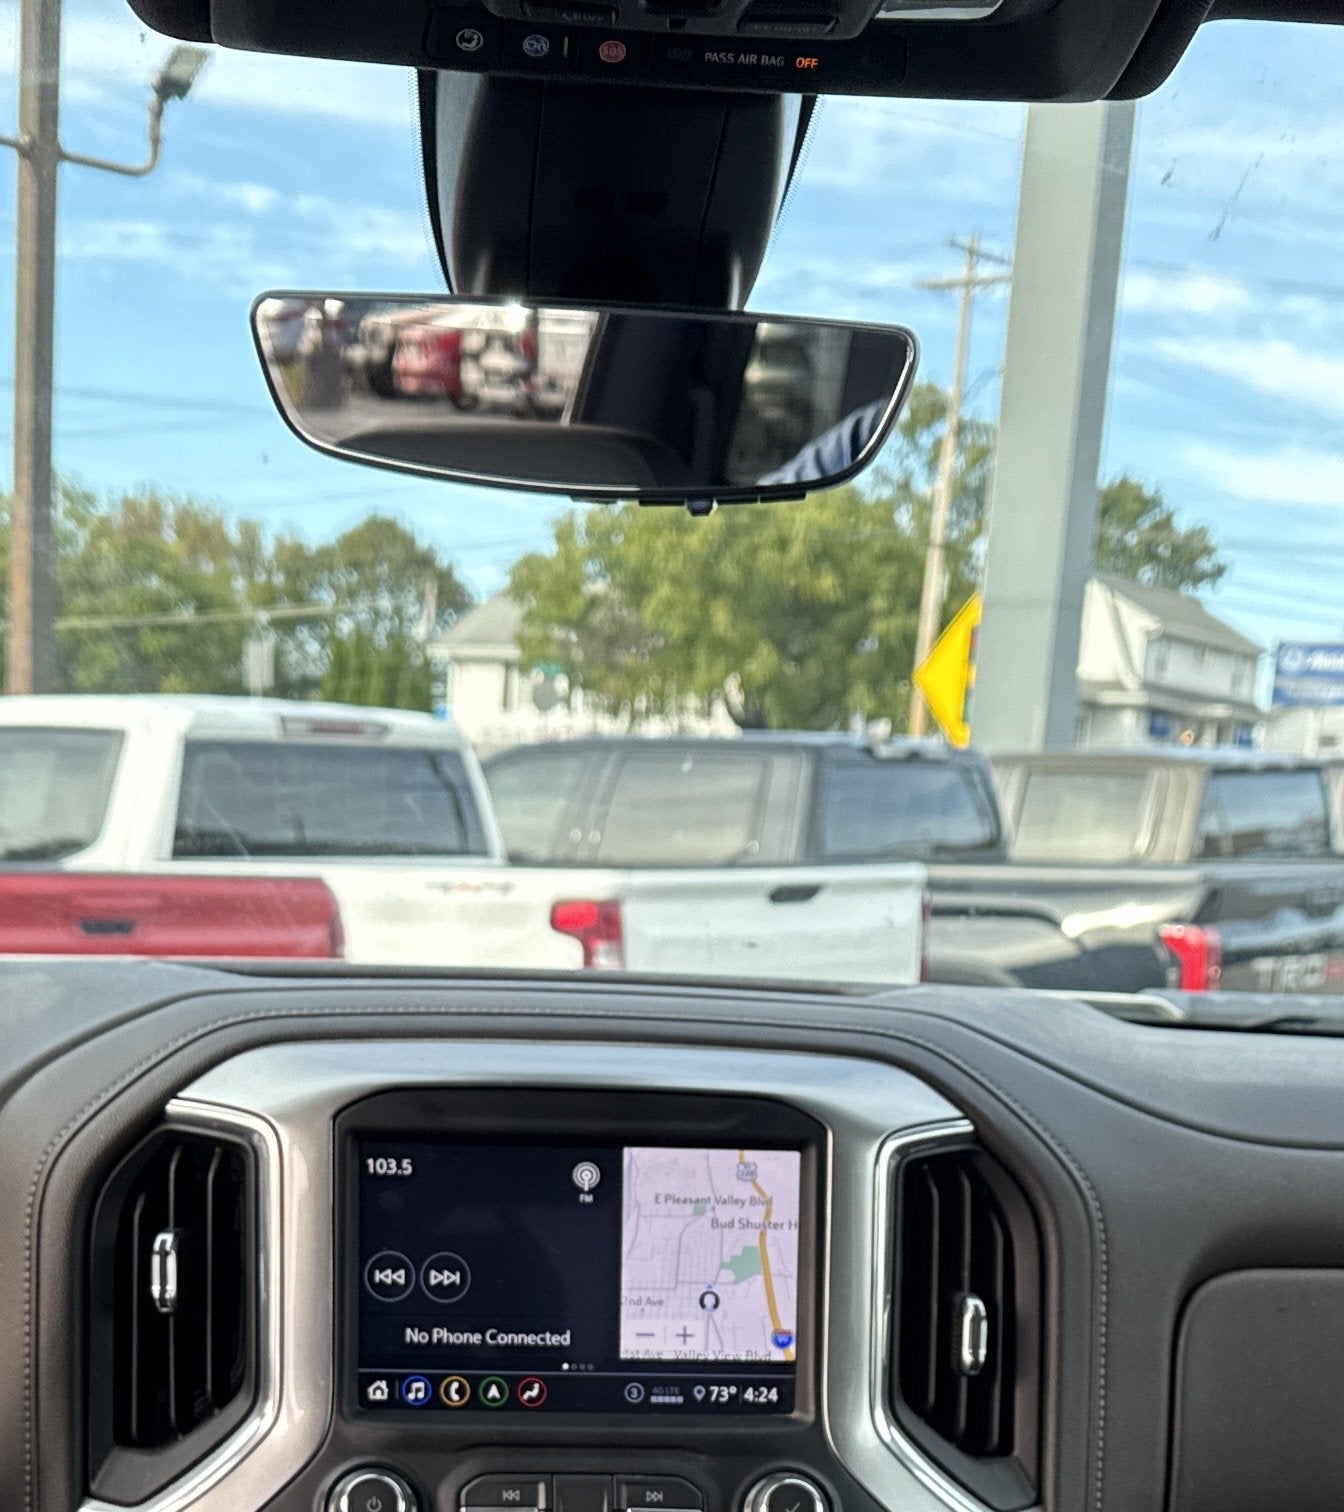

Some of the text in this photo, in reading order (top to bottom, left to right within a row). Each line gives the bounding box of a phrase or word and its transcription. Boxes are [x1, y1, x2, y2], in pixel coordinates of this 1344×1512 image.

[705, 52, 734, 64] PASS
[737, 53, 757, 65] AIR
[761, 54, 785, 67] BAG
[795, 56, 819, 69] OFF
[366, 1157, 413, 1176] 103.5
[579, 1193, 594, 1203] FM
[654, 1194, 661, 1204] E
[665, 1194, 711, 1205] Pleasant
[714, 1195, 746, 1208] Valley
[711, 1218, 735, 1229] Bud
[738, 1218, 784, 1230] Shuster
[405, 1327, 571, 1346] No Phone Connected
[709, 1385, 737, 1402] 73°
[744, 1386, 779, 1403] 4:24
